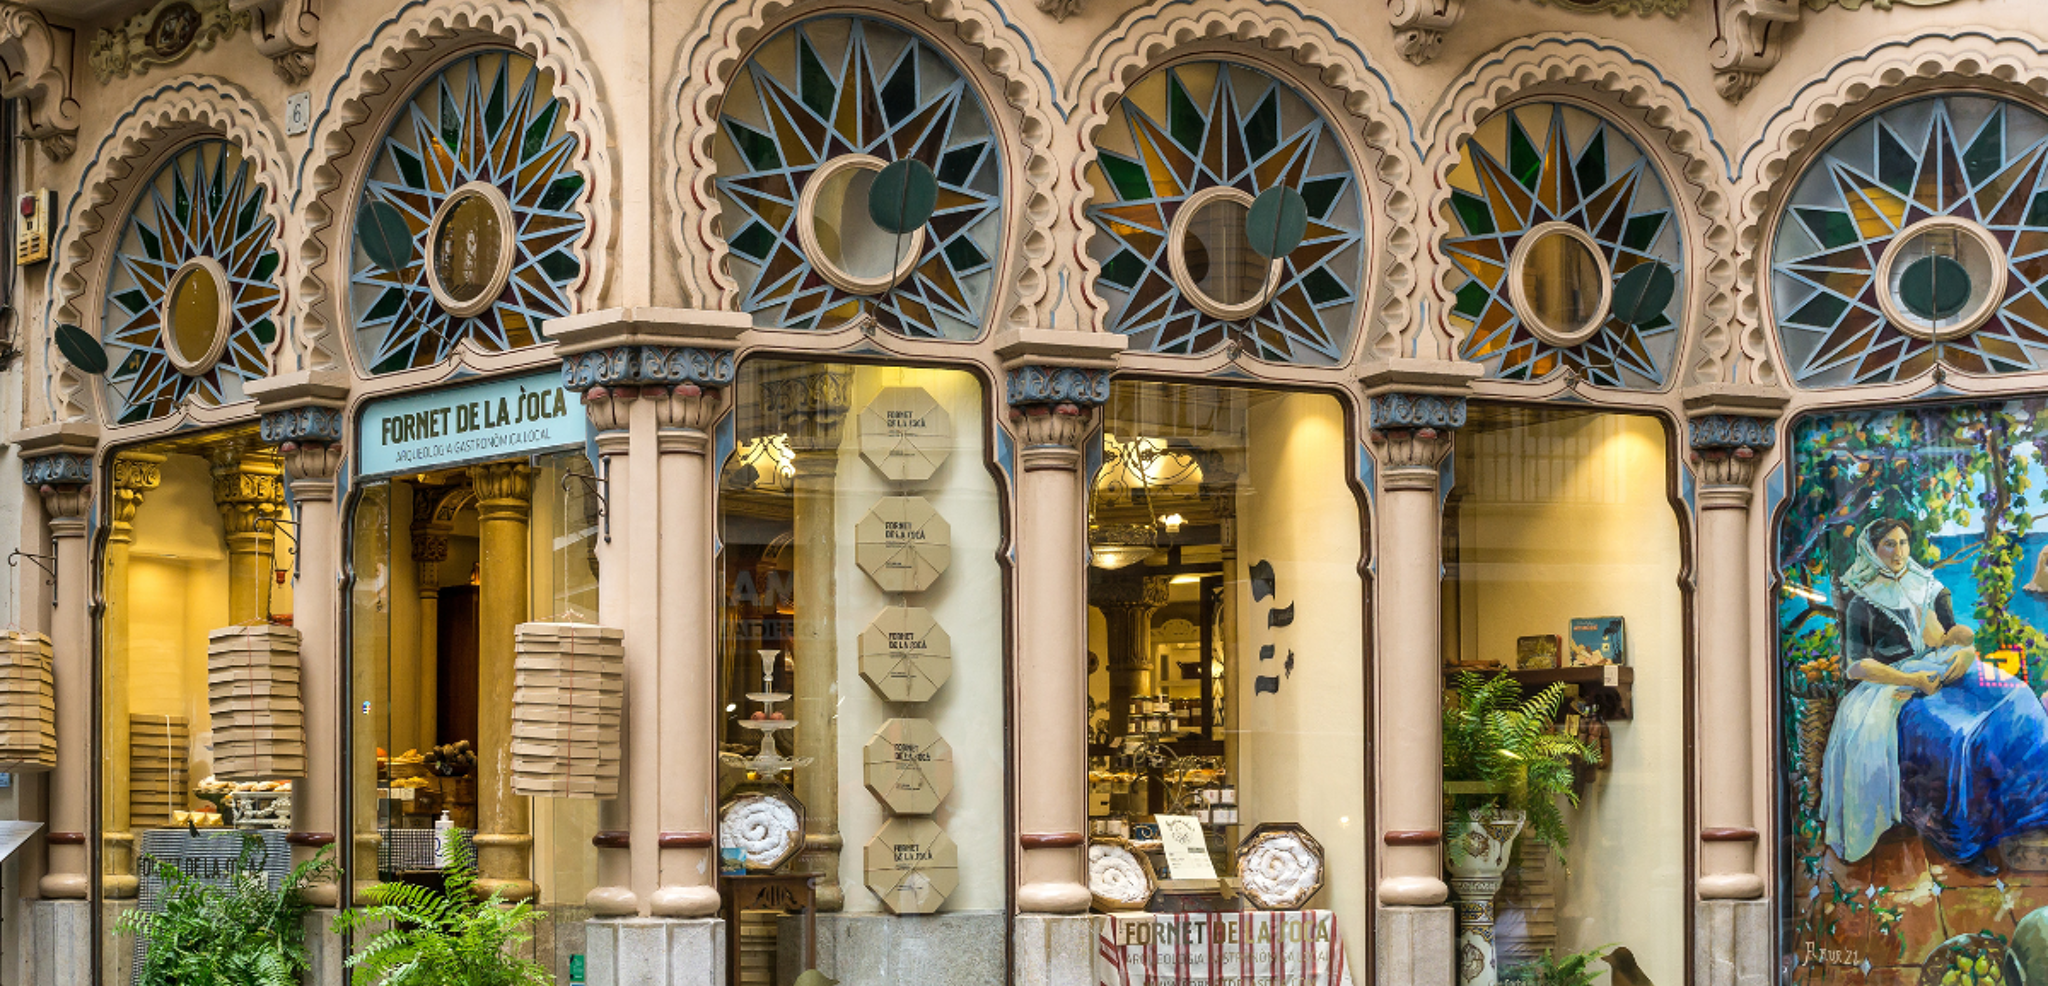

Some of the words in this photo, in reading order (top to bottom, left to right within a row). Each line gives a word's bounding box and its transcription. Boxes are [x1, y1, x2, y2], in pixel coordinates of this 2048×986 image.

[293, 103, 301, 123] 6
[381, 407, 452, 446] FORNET
[456, 402, 480, 433] DE
[484, 397, 511, 429] LA
[523, 428, 551, 443] LOCAL
[204, 858, 221, 879] LA
[1126, 921, 1207, 946] FORNET
[1213, 921, 1238, 944] DE
[1245, 921, 1271, 944] LA
[1277, 919, 1330, 943] SOCA
